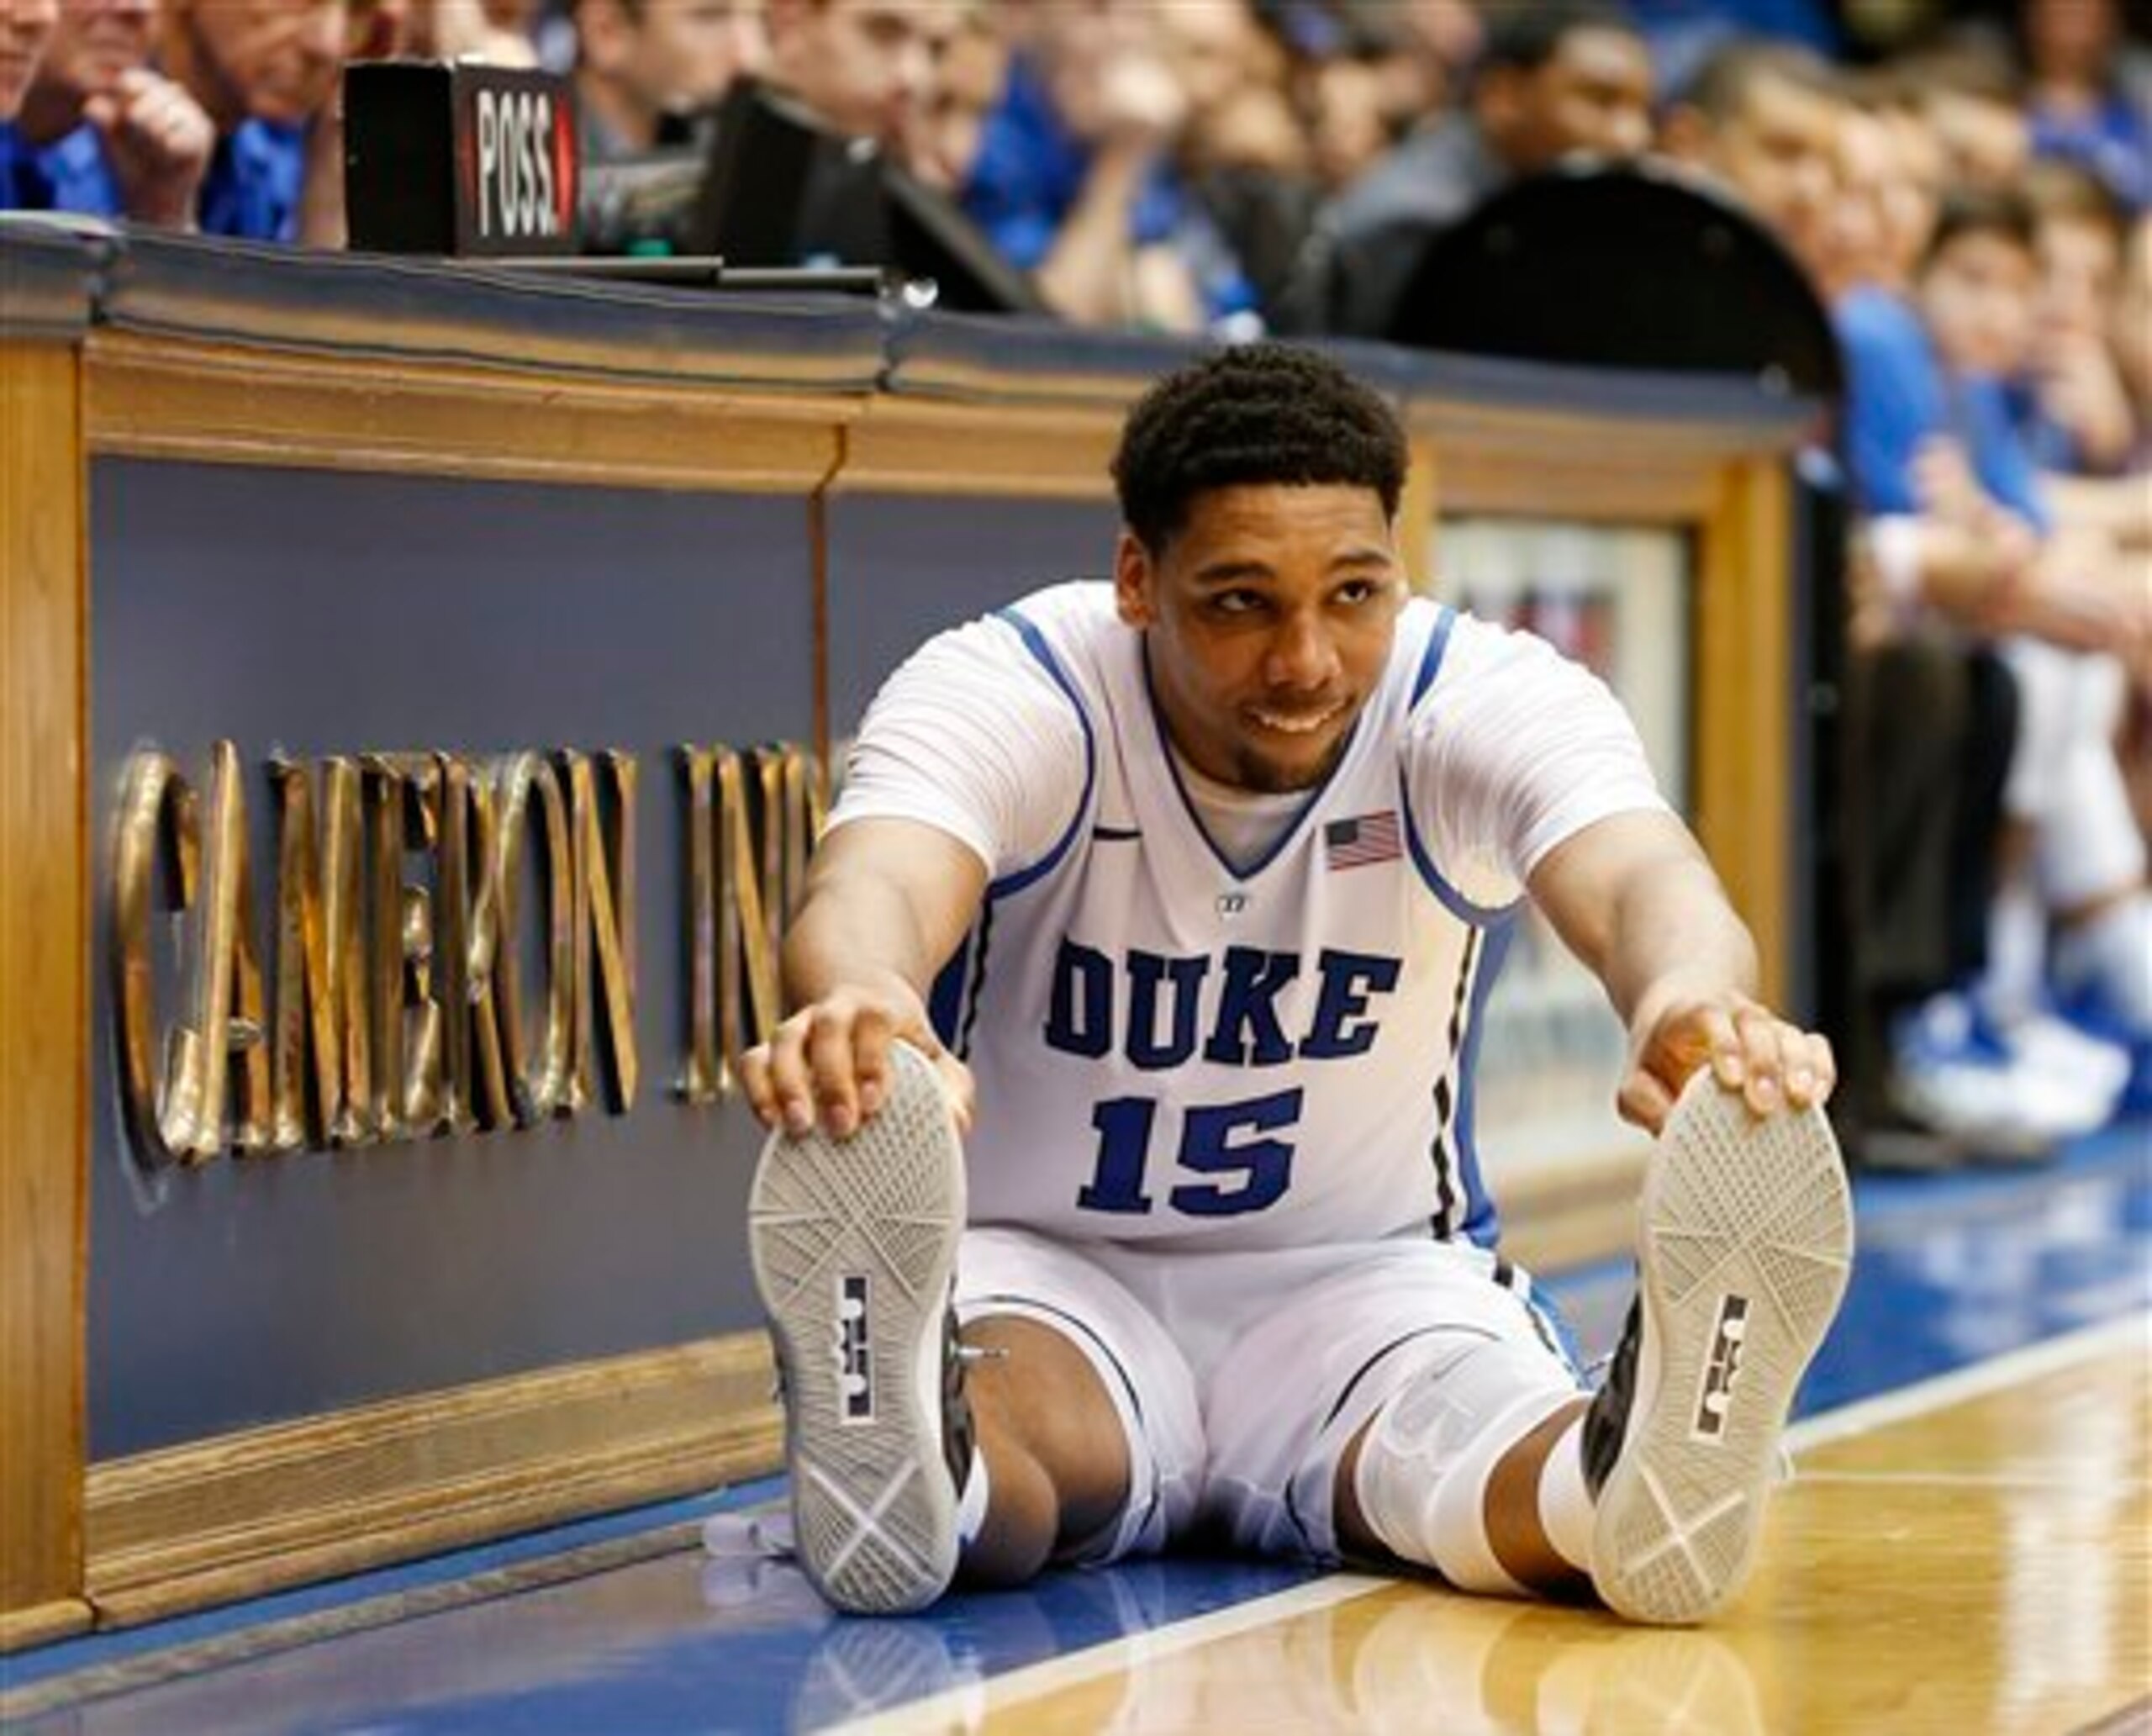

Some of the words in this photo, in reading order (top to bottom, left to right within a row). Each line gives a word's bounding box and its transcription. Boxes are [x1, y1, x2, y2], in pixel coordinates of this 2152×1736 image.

[113, 738, 639, 1169] CAMERON
[668, 741, 829, 1105] IN
[1044, 935, 1403, 1071] DUKE
[1076, 1086, 1305, 1216] 15
